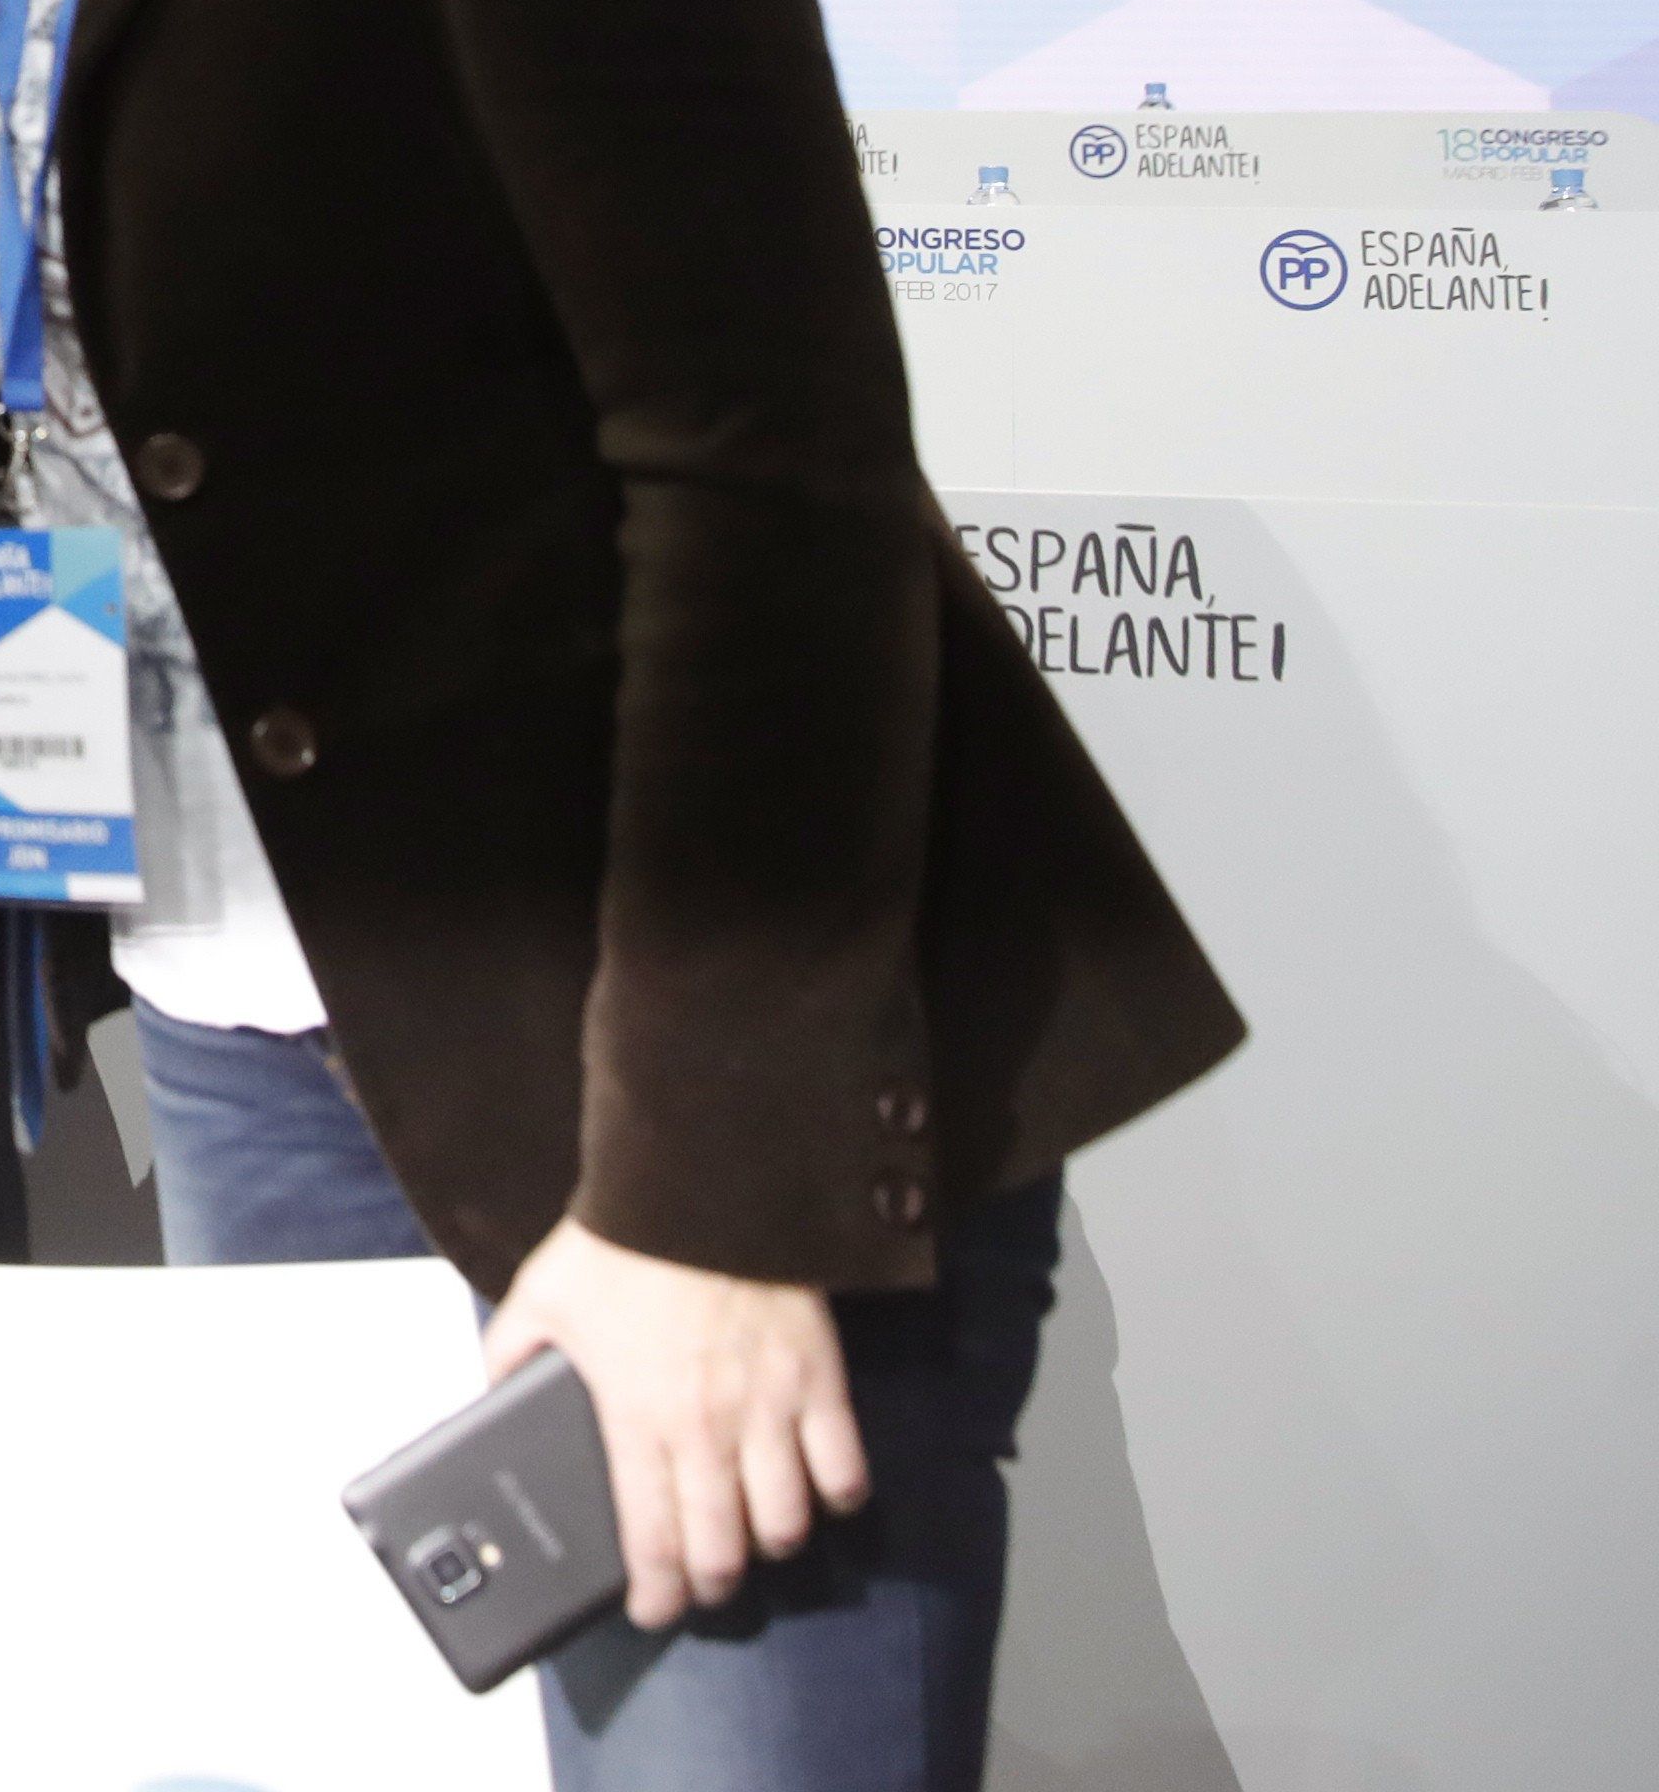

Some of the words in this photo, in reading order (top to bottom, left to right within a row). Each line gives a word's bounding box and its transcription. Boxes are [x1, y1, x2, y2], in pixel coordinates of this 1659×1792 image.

[1437, 129, 1479, 161] 18
[1480, 129, 1609, 147] CONGRESO
[1481, 146, 1589, 163] POPULAR
[1137, 152, 1261, 184] ADELANTE!
[874, 226, 1026, 252] ONGRESO
[1361, 227, 1510, 273] ESPAÑA,
[895, 281, 935, 301] FEB
[943, 282, 999, 303] 2017
[1364, 273, 1551, 321] ADELANTE!
